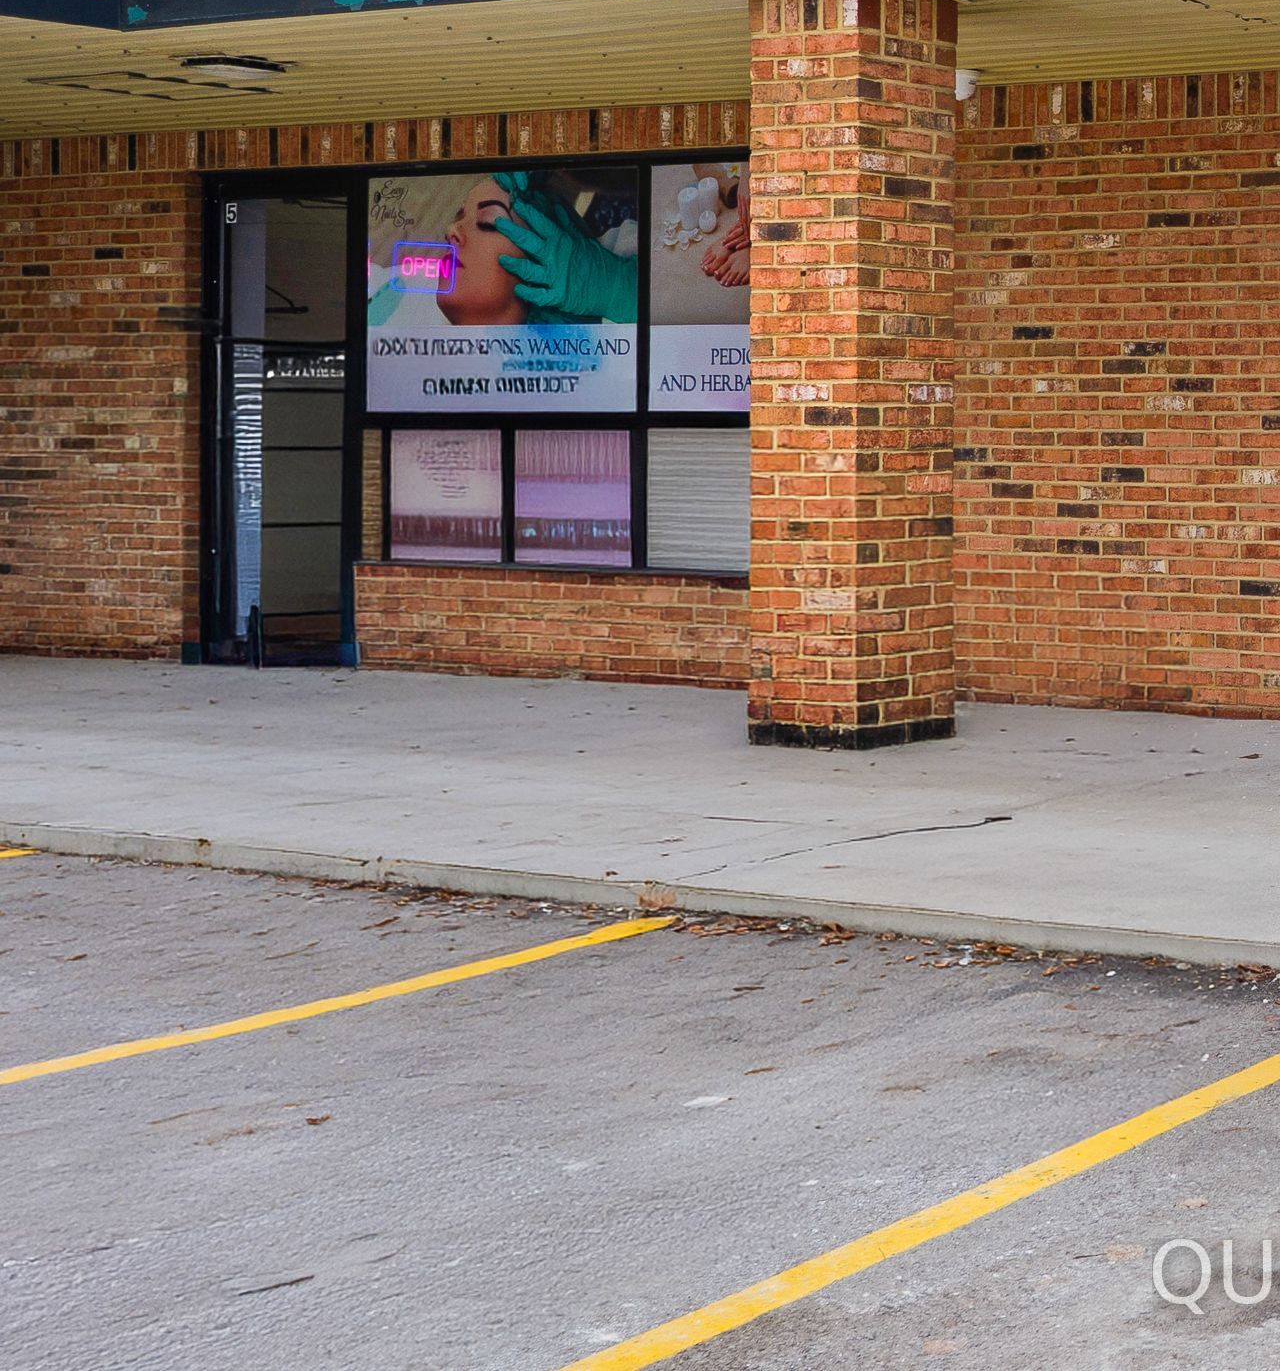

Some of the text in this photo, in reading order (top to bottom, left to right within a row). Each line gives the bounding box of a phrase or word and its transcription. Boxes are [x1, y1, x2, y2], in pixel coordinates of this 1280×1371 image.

[226, 204, 238, 223] 5
[401, 255, 451, 279] OPEN
[528, 338, 591, 356] WAXING
[594, 338, 631, 356] AND
[658, 374, 697, 392] AND
